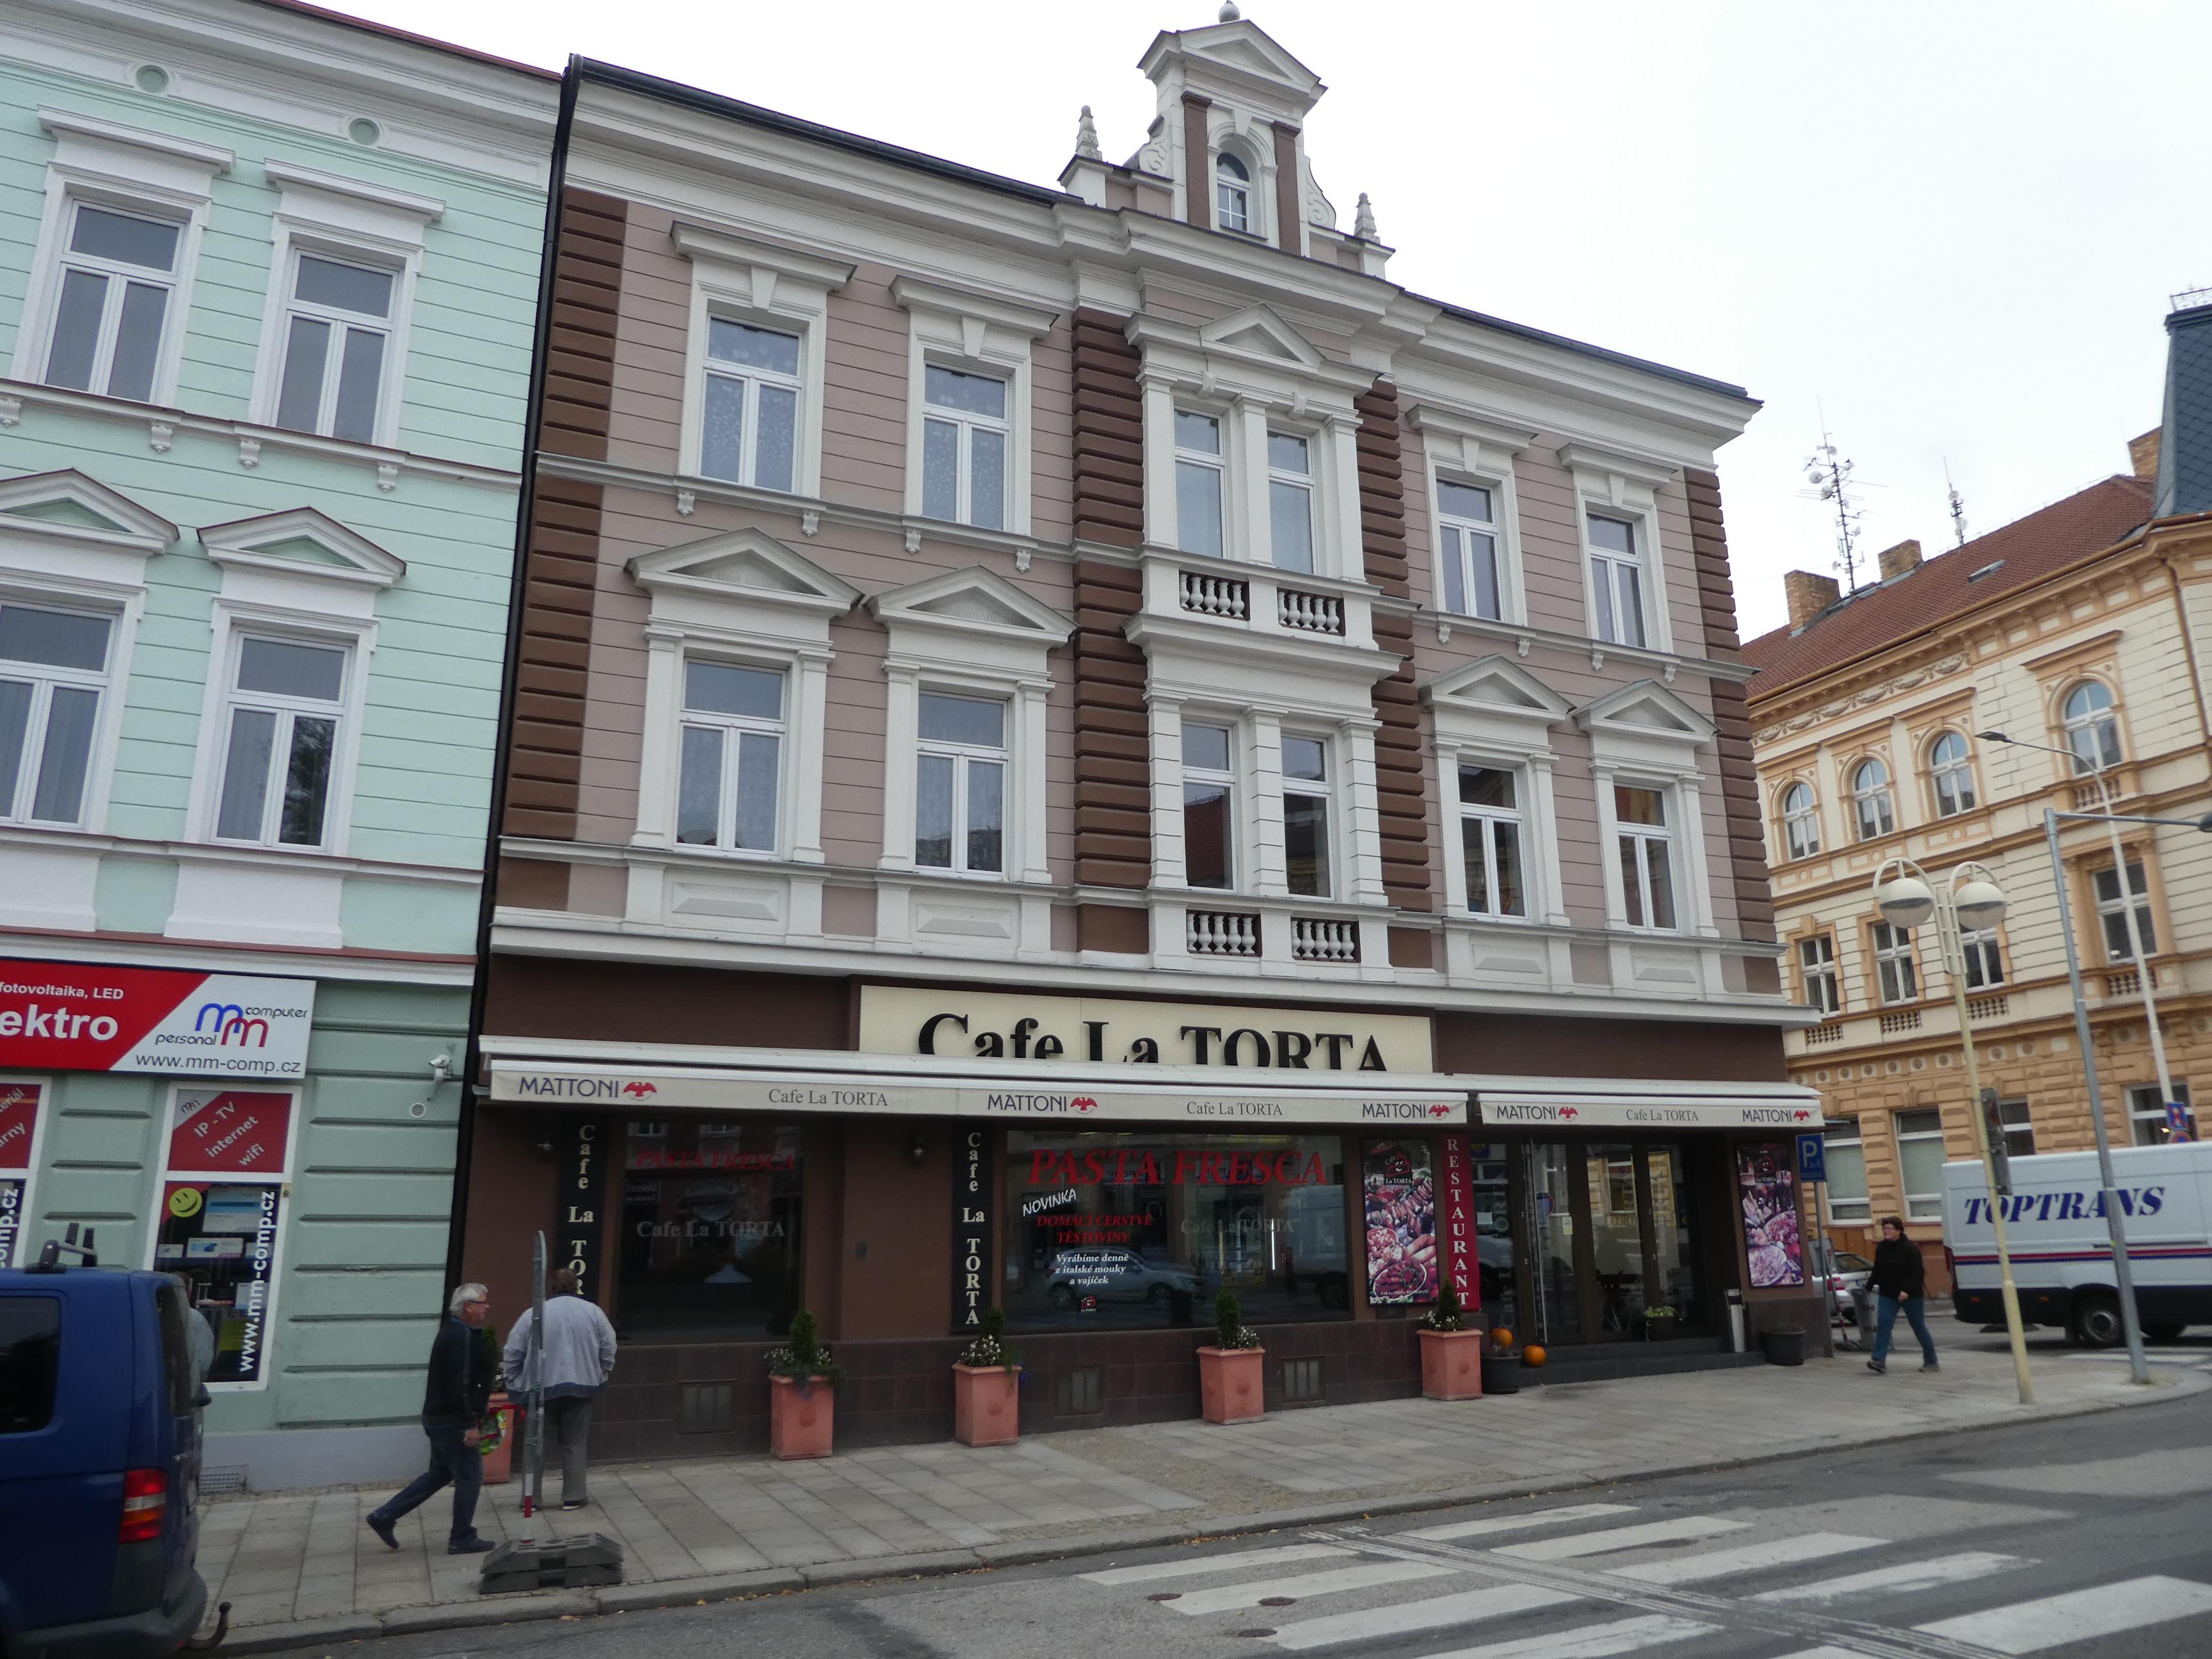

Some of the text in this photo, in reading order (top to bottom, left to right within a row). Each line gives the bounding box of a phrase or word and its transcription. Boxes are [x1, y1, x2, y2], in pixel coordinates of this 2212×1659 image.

[93, 987, 124, 1000] LED
[244, 1006, 308, 1019] computer
[154, 1034, 217, 1045] personal
[918, 1013, 1388, 1071] Cafe La TORTA
[135, 1055, 301, 1075] www.mm-comp.cz
[519, 1076, 619, 1098] MATTONI
[769, 1089, 888, 1105] Cafe La TORTA
[987, 1094, 1067, 1112] MATTONI
[1187, 1101, 1283, 1116] Cafe La TORTA
[1362, 1103, 1426, 1118] MATTONI
[1496, 1105, 1557, 1119] MATTONI
[1626, 1109, 1699, 1121] Cafe La TORTA
[1742, 1109, 1792, 1123] MATTONI
[194, 1121, 209, 1137] IP
[215, 1101, 236, 1119] TV
[205, 1115, 259, 1158] internet
[239, 1142, 265, 1166] wifi
[636, 1150, 796, 1171] PASTA FRESCA
[1802, 1141, 1818, 1167] P
[1027, 1149, 1328, 1185] PASTA FRESCA
[568, 1125, 595, 1295] Cafe La TOR
[1022, 1188, 1077, 1217] NOVINKA
[1965, 1186, 2165, 1224] TOPTRANS
[636, 1221, 787, 1237] Cafe La TORTA
[962, 1132, 985, 1324] Cafe La TORTA
[1180, 1219, 1214, 1233] Cafe
[1219, 1219, 1237, 1233] La
[1447, 1139, 1469, 1305] RESTAURANT
[1056, 1253, 1129, 1265] Vyrábíme denně
[1062, 1264, 1093, 1274] italské
[1094, 1264, 1126, 1274] mouky
[239, 1191, 276, 1372] www.mm-comp.cz
[1078, 1275, 1109, 1286] vajíček
